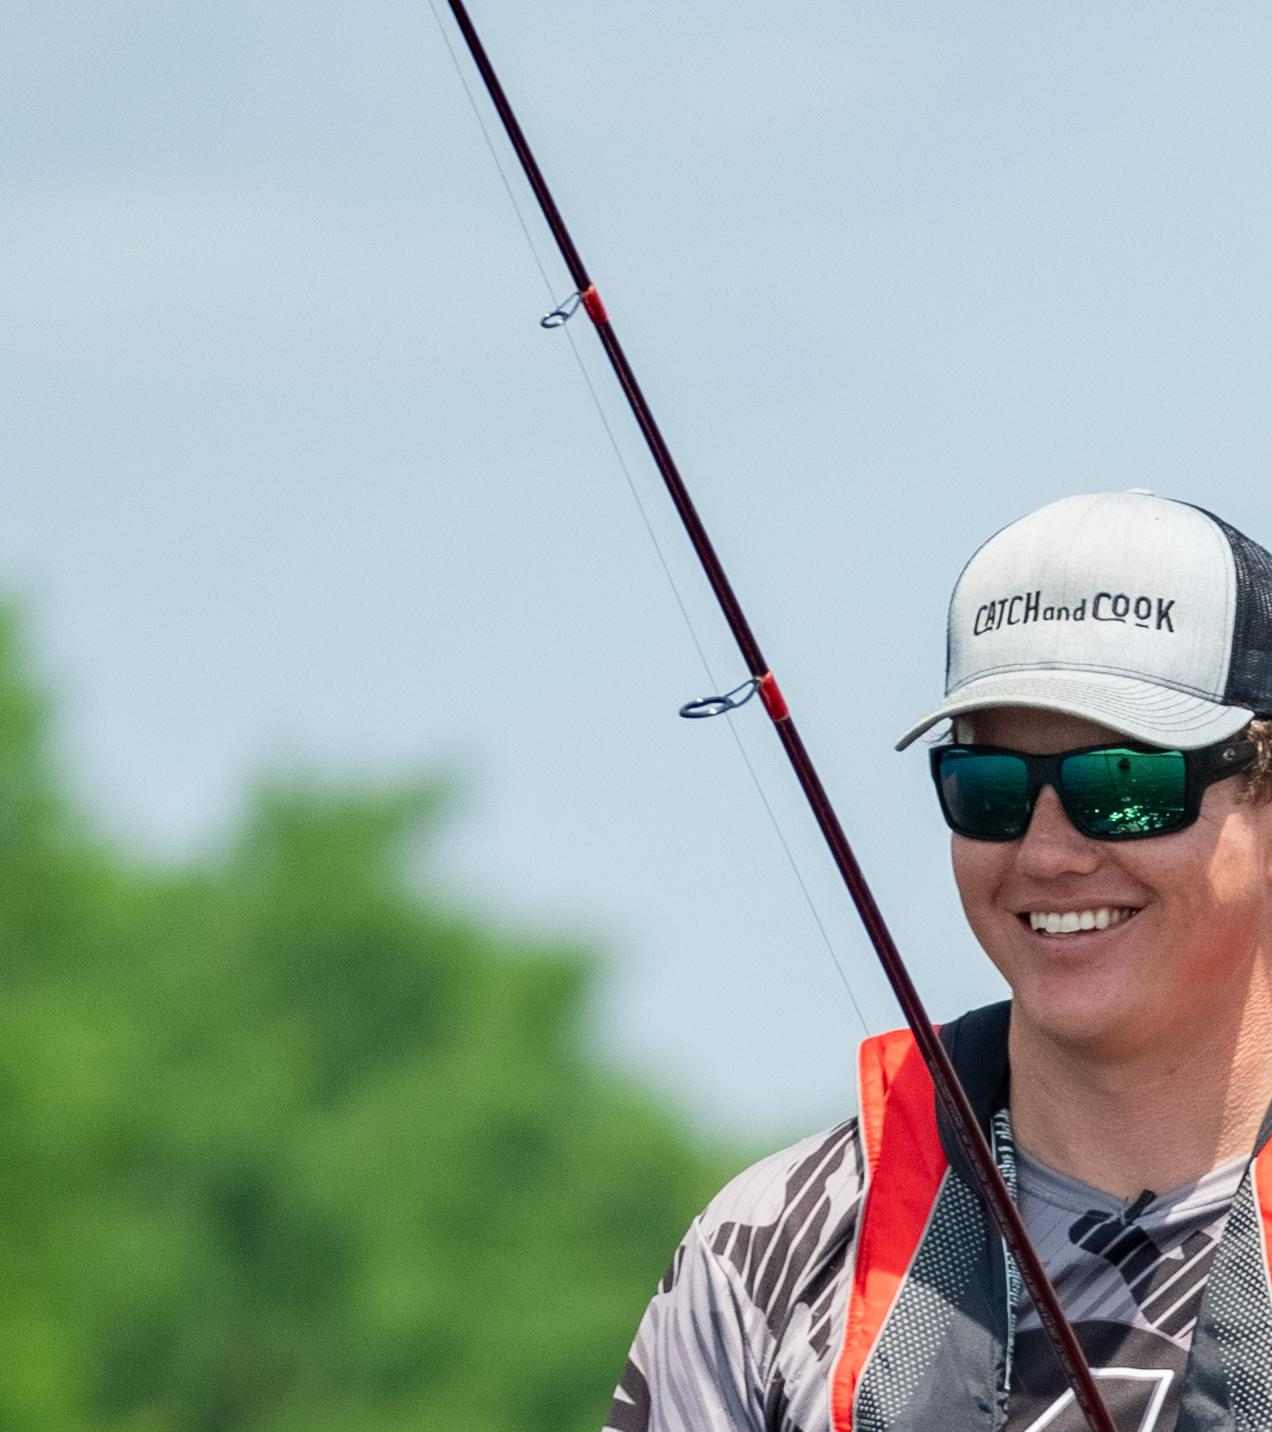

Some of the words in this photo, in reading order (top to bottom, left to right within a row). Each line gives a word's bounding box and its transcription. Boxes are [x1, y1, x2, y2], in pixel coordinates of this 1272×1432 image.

[974, 591, 1041, 635] CATCH
[1042, 598, 1087, 622] and
[1092, 592, 1176, 634] COOK
